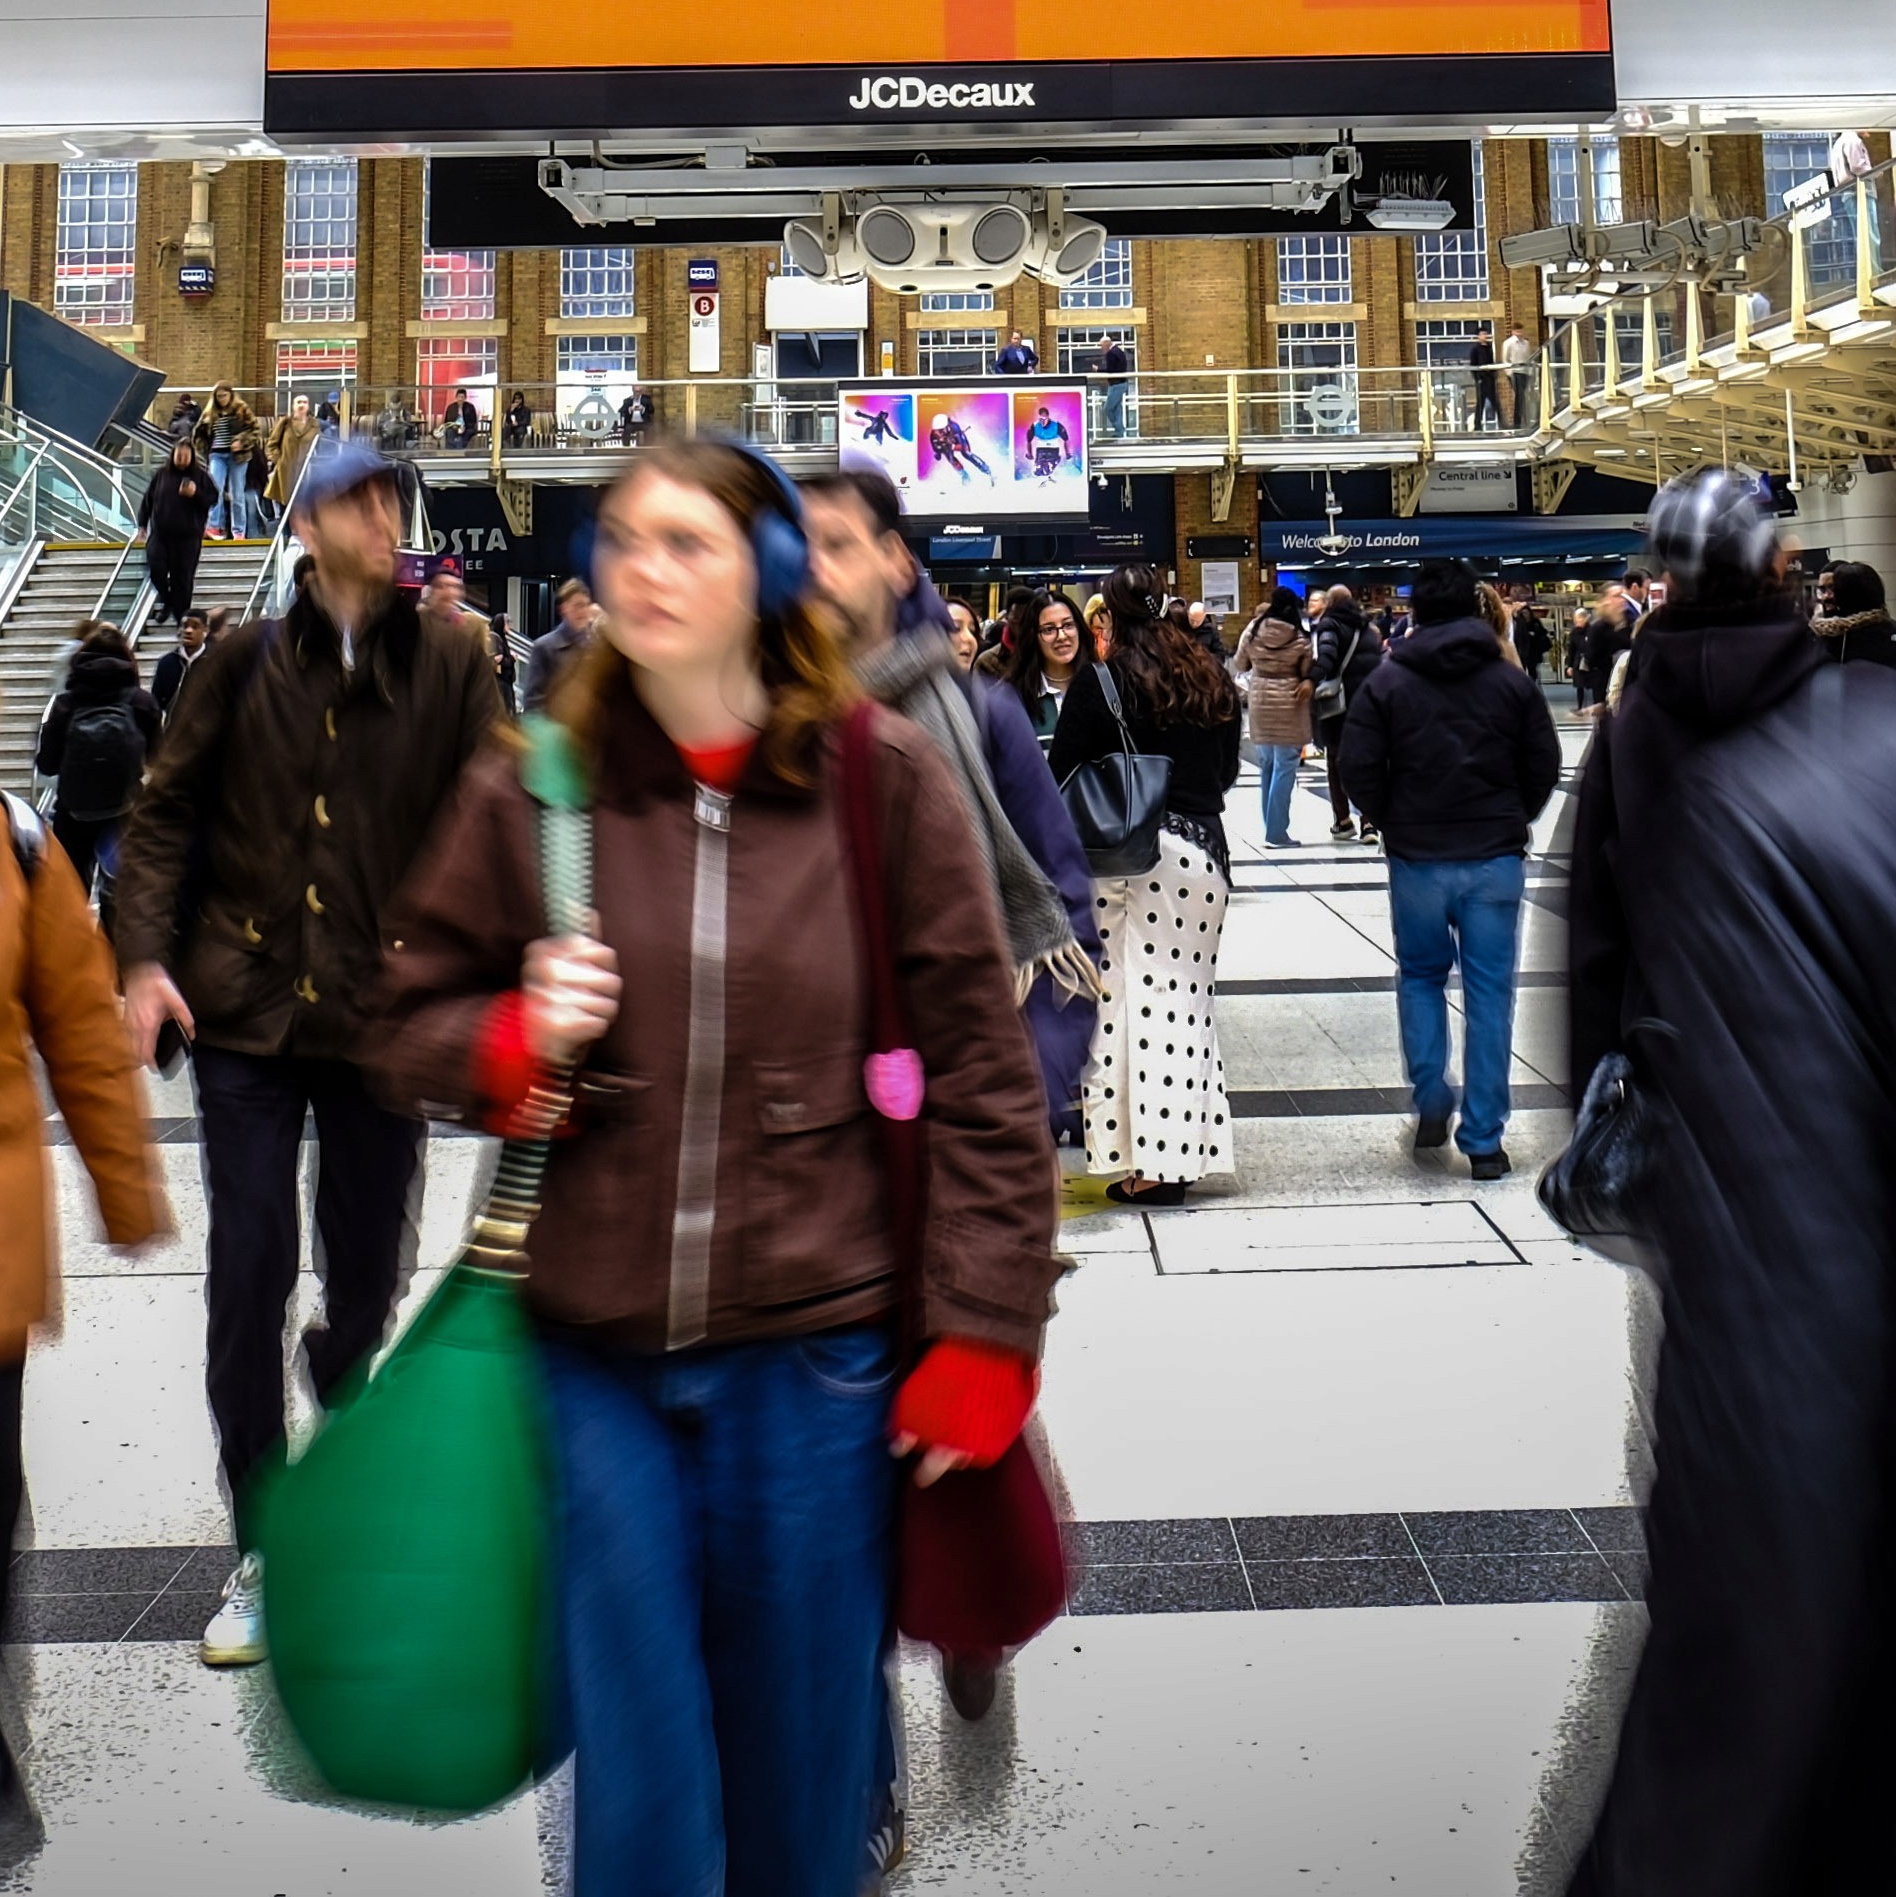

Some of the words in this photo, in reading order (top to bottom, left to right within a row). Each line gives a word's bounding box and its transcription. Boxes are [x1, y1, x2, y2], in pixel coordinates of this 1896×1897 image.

[849, 78, 1035, 111] JCDecaux
[700, 300, 709, 312] B
[1439, 470, 1478, 481] Central
[1481, 470, 1501, 481] line
[432, 528, 507, 555] OSTA
[1282, 535, 1347, 549] Welco
[1366, 533, 1420, 547] London
